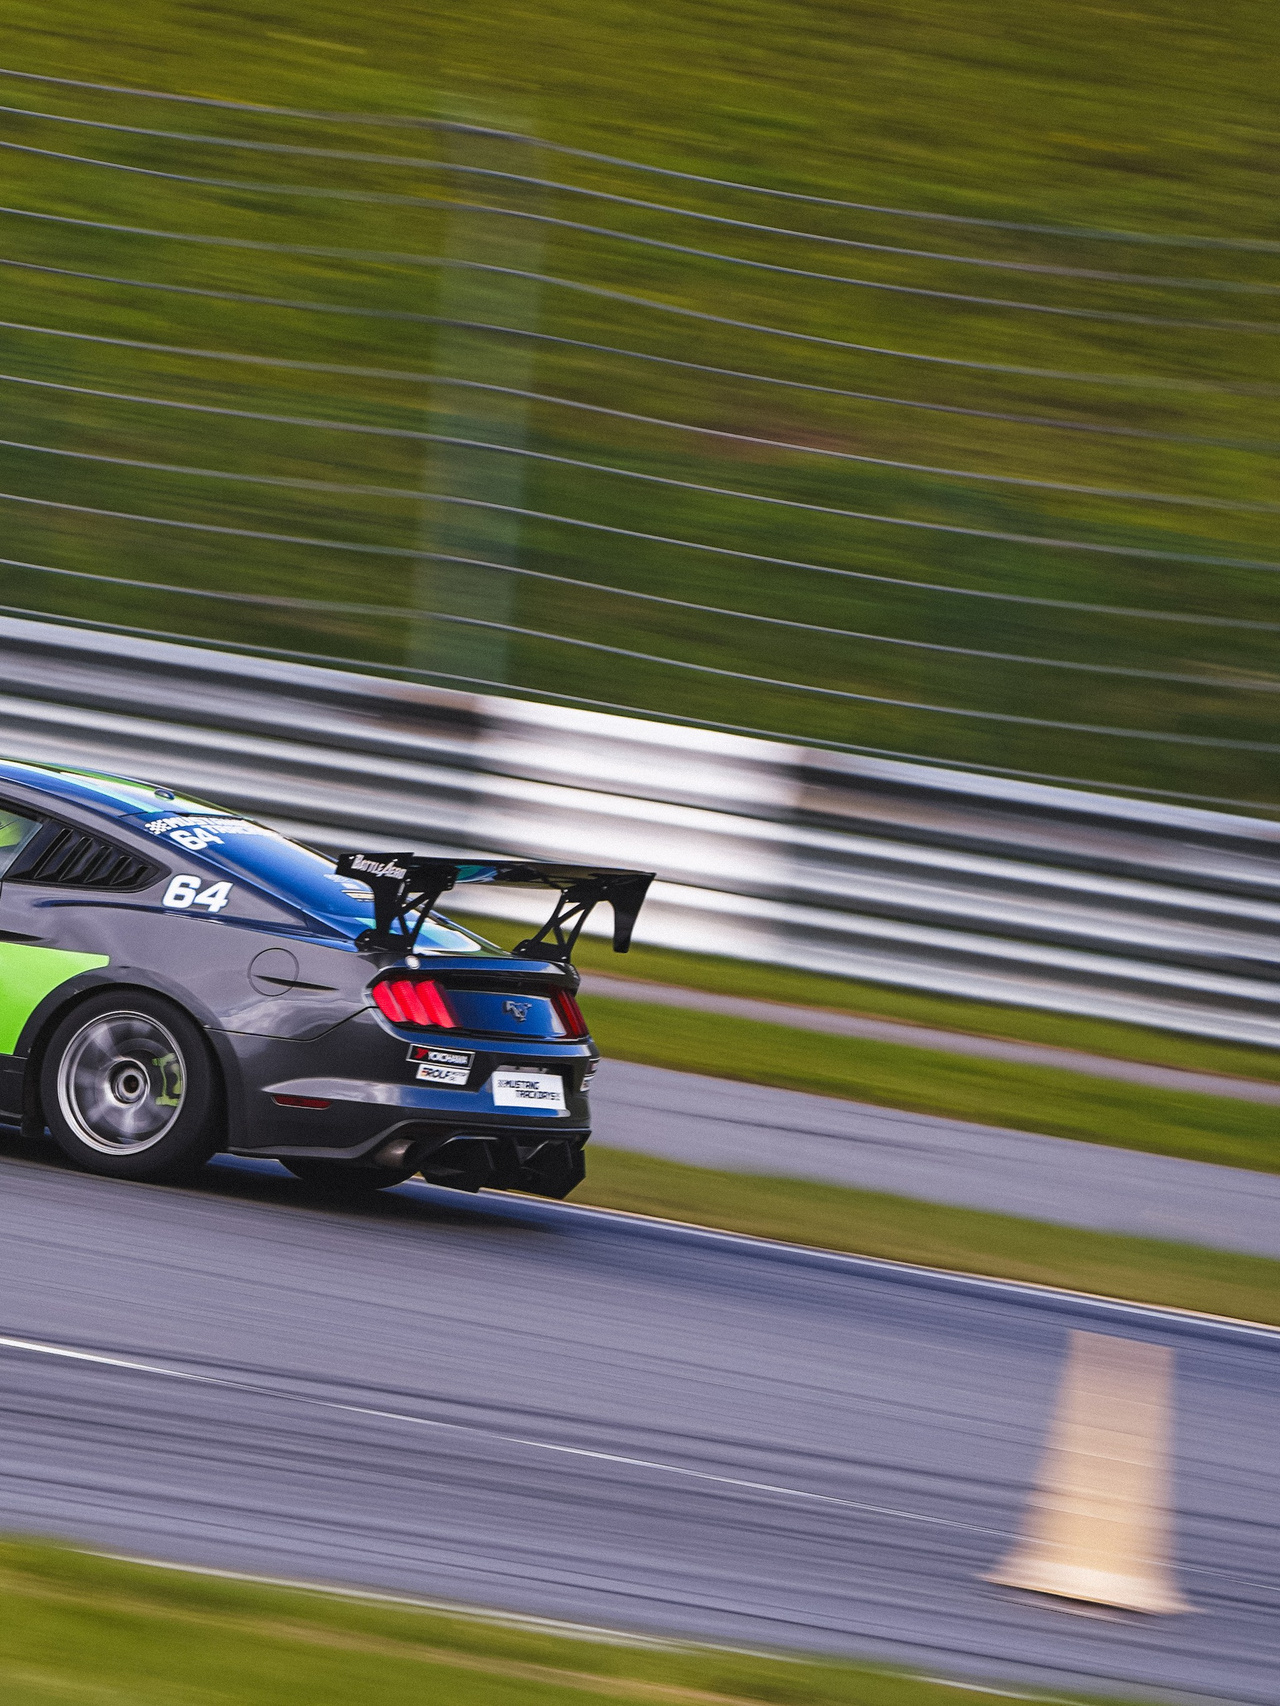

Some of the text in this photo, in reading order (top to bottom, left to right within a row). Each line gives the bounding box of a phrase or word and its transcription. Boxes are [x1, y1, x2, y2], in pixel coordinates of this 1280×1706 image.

[170, 827, 225, 850] 64
[162, 874, 234, 913] 64
[427, 1051, 469, 1065] YOKOHAMA
[505, 1080, 540, 1090] MUSTANG
